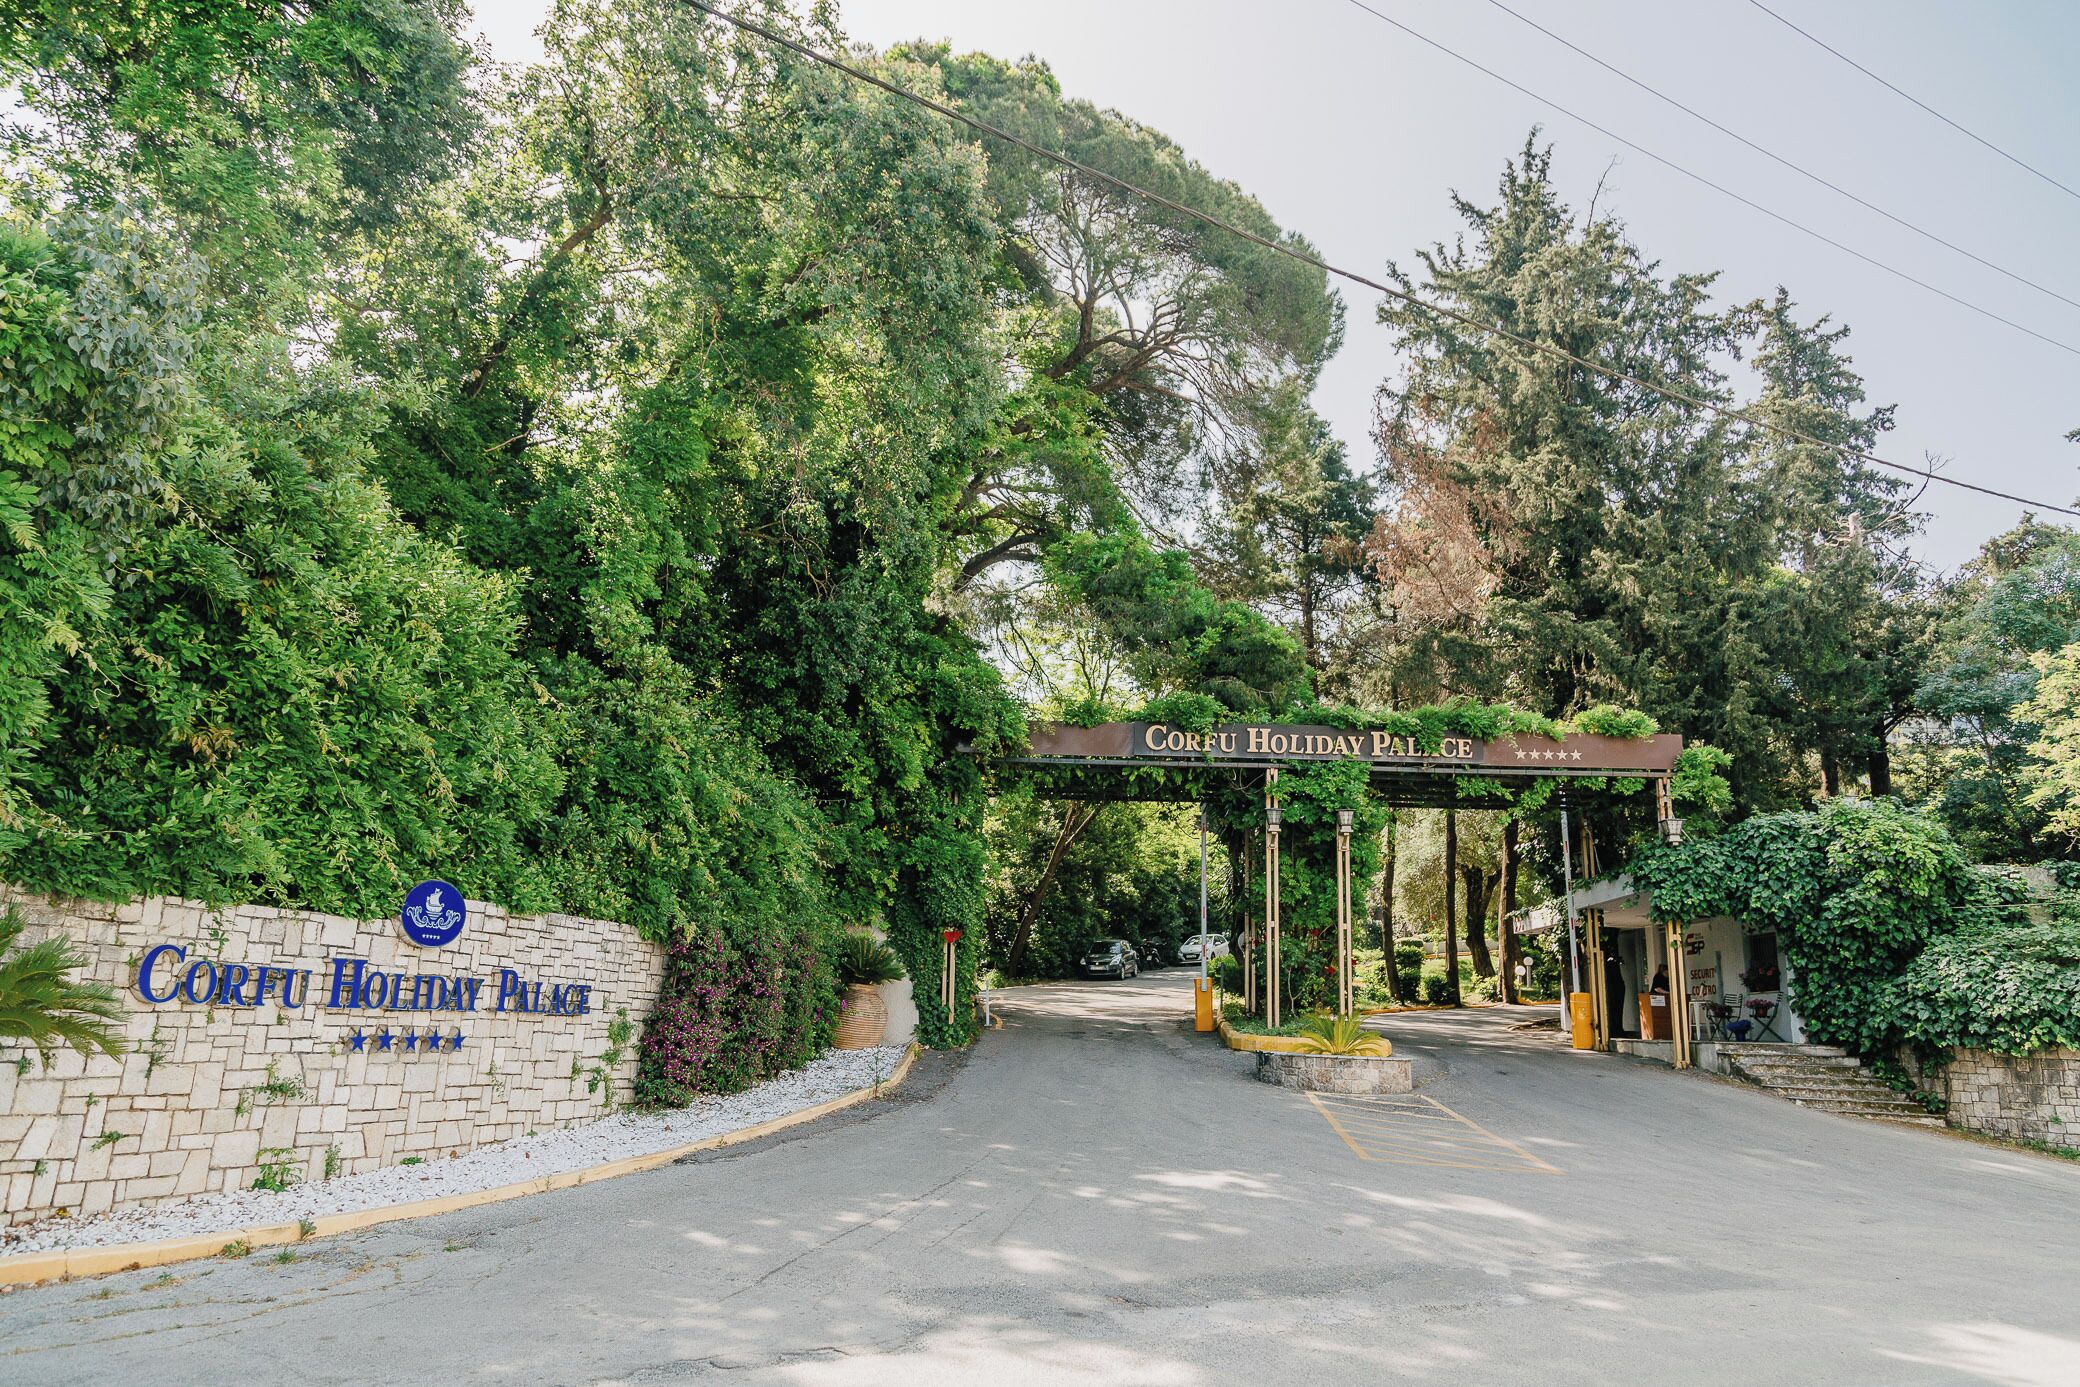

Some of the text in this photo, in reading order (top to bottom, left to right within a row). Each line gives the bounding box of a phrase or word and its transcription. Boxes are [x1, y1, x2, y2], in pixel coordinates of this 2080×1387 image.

[1145, 724, 1473, 758] CORFU HOLIDAY PALCE
[138, 943, 592, 1015] CORFU HOLIDAY PALACE
[1690, 967, 1717, 980] SECURIT
[1692, 983, 1717, 997] COTRO
